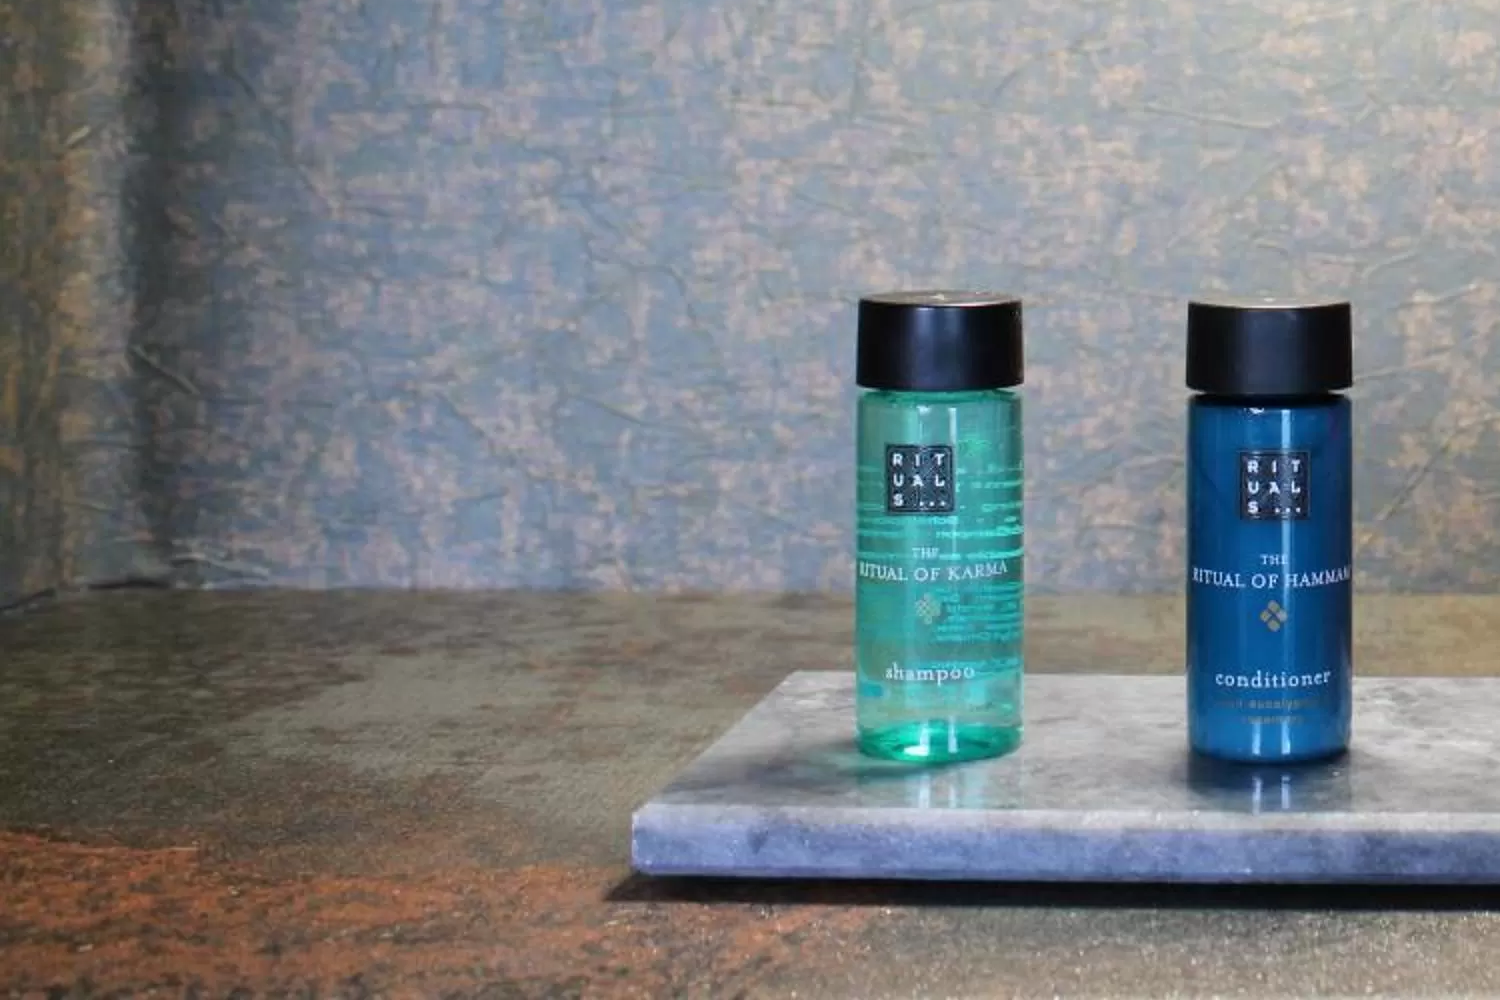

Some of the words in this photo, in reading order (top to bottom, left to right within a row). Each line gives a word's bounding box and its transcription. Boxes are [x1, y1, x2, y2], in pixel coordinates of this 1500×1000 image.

[1259, 554, 1289, 565] THE
[913, 567, 940, 582] OF
[947, 560, 1008, 581] KARMA
[1192, 567, 1246, 588] RITUAL
[1251, 574, 1279, 589] OF
[885, 662, 976, 687] shampoo
[1215, 669, 1331, 689] conditioner
